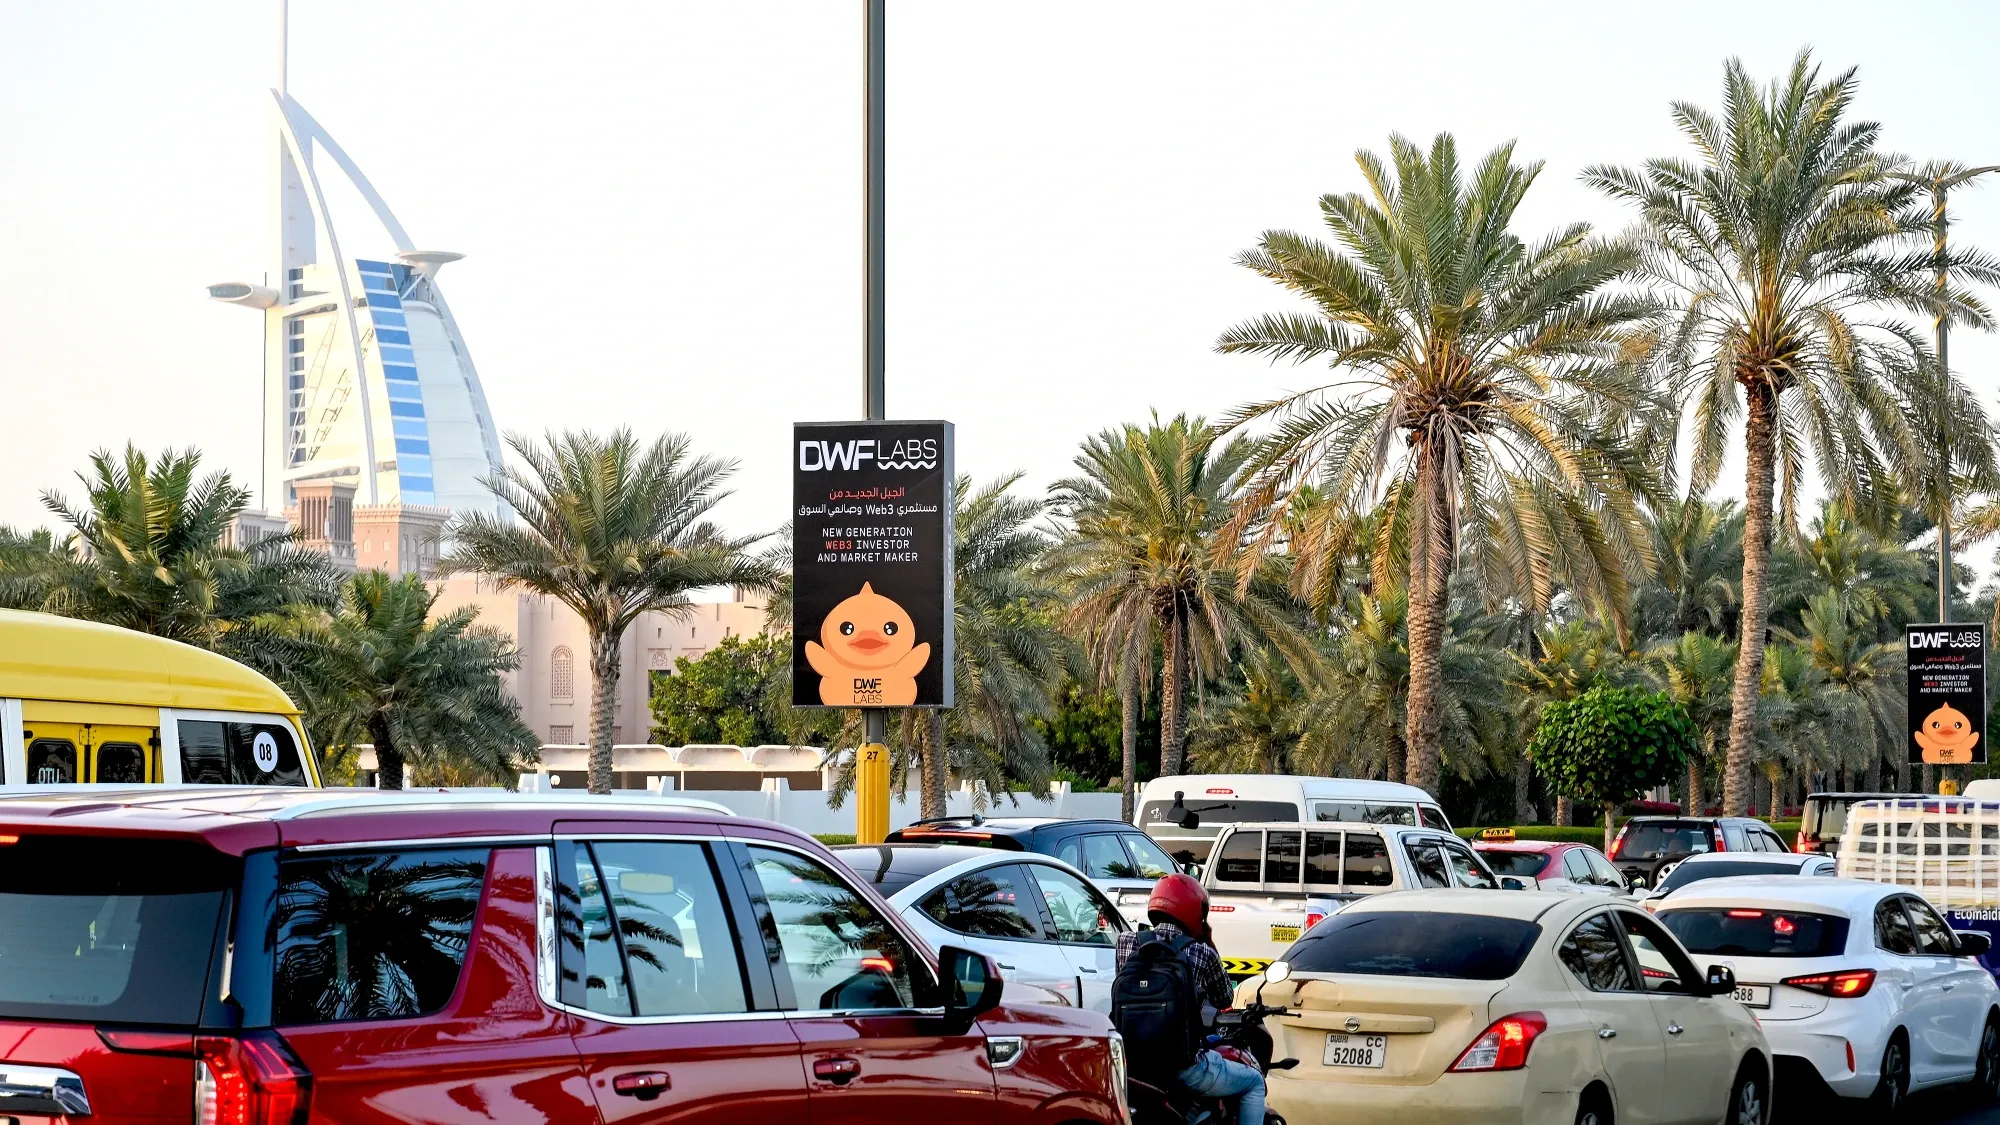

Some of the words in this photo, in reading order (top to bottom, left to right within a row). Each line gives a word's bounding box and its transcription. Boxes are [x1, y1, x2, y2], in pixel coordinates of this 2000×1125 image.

[799, 440, 876, 471] DWF
[877, 439, 937, 460] LABS
[829, 489, 844, 500] من
[798, 503, 827, 516] السوق
[865, 503, 894, 516] Web3
[896, 502, 938, 517] مستثمري
[822, 527, 843, 538] NEW
[845, 526, 914, 538] GENERATION
[825, 540, 852, 550] WEB3
[856, 539, 910, 550] INVESTOR
[817, 552, 838, 562] AND
[840, 552, 881, 562] MARKET
[884, 551, 919, 562] MAKER
[1910, 632, 1949, 648] DWF
[1950, 632, 1980, 642] LABS
[853, 678, 882, 690] DWF
[853, 694, 883, 705] LABS
[258, 742, 273, 762] 08
[866, 751, 879, 760] 27
[1366, 1036, 1383, 1048] CC
[1333, 1047, 1373, 1066] 52088
